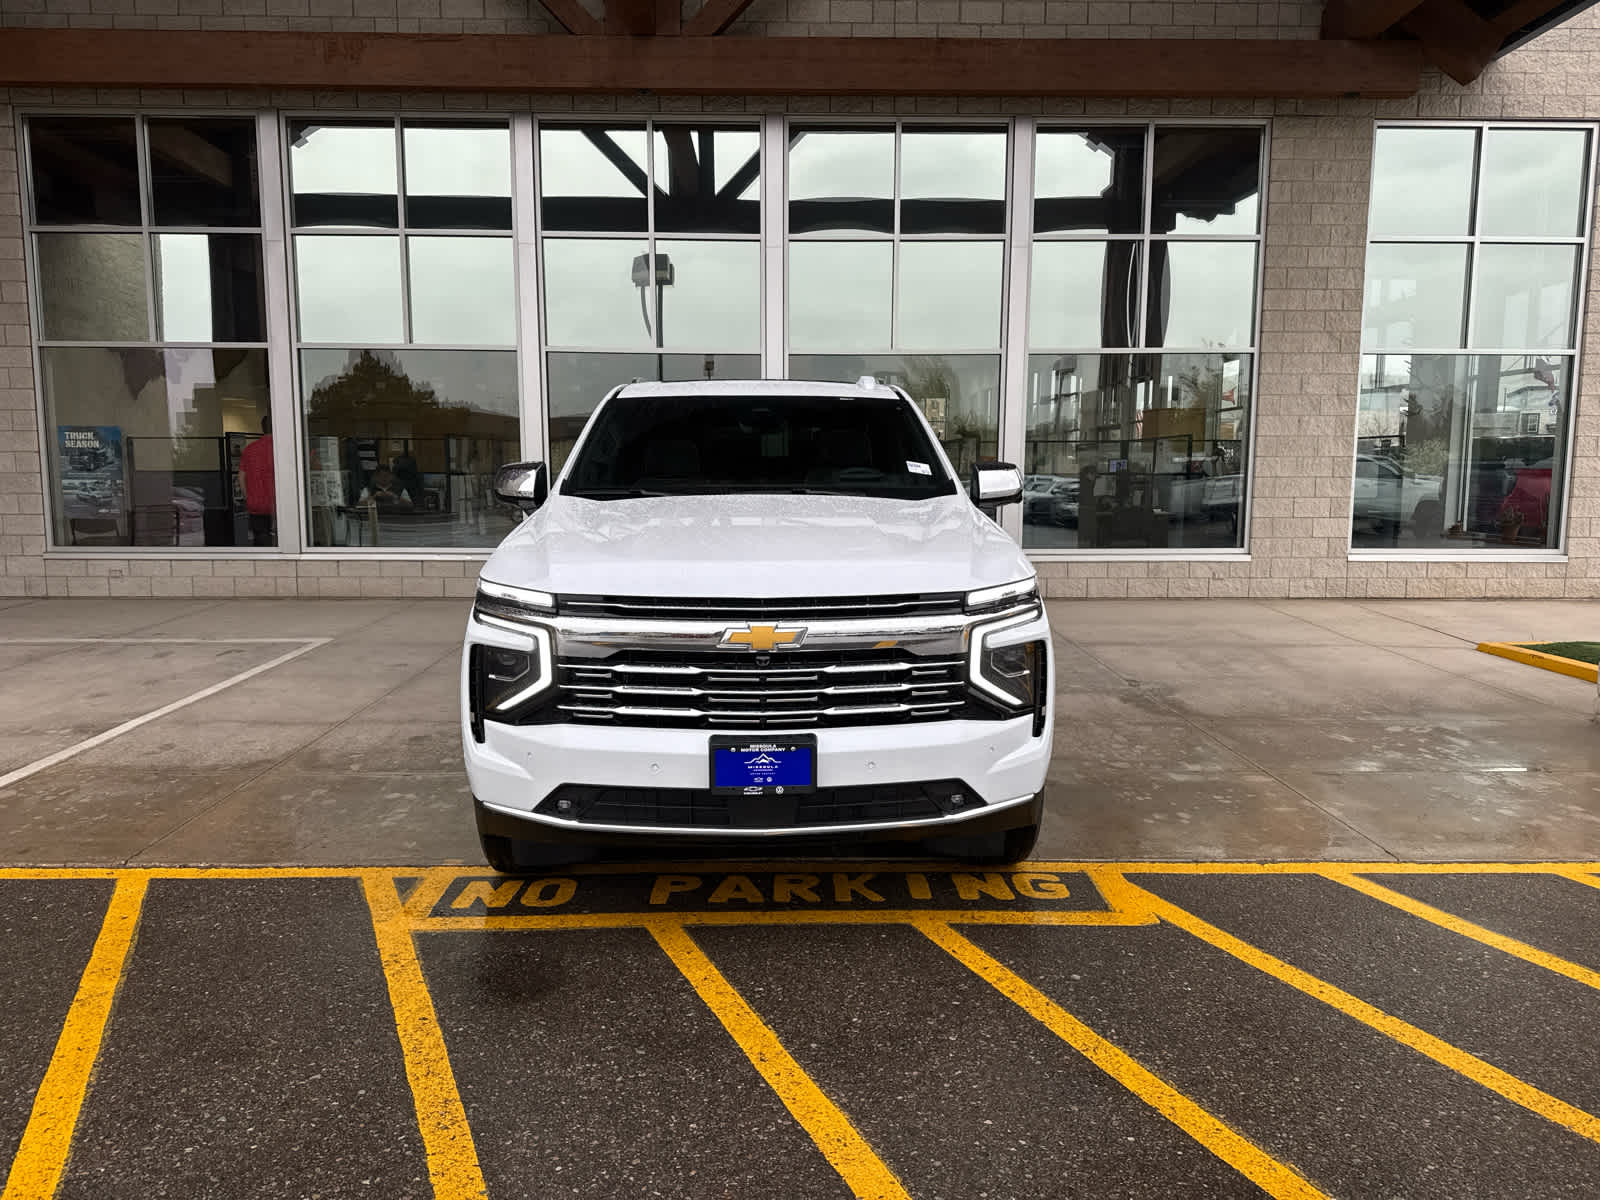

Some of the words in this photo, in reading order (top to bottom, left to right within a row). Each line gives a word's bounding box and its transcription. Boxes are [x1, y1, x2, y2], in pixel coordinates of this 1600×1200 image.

[64, 431, 95, 440] TRUCK
[65, 440, 100, 448] SEASON
[450, 877, 579, 908] NO
[648, 873, 1071, 905] PARKING
